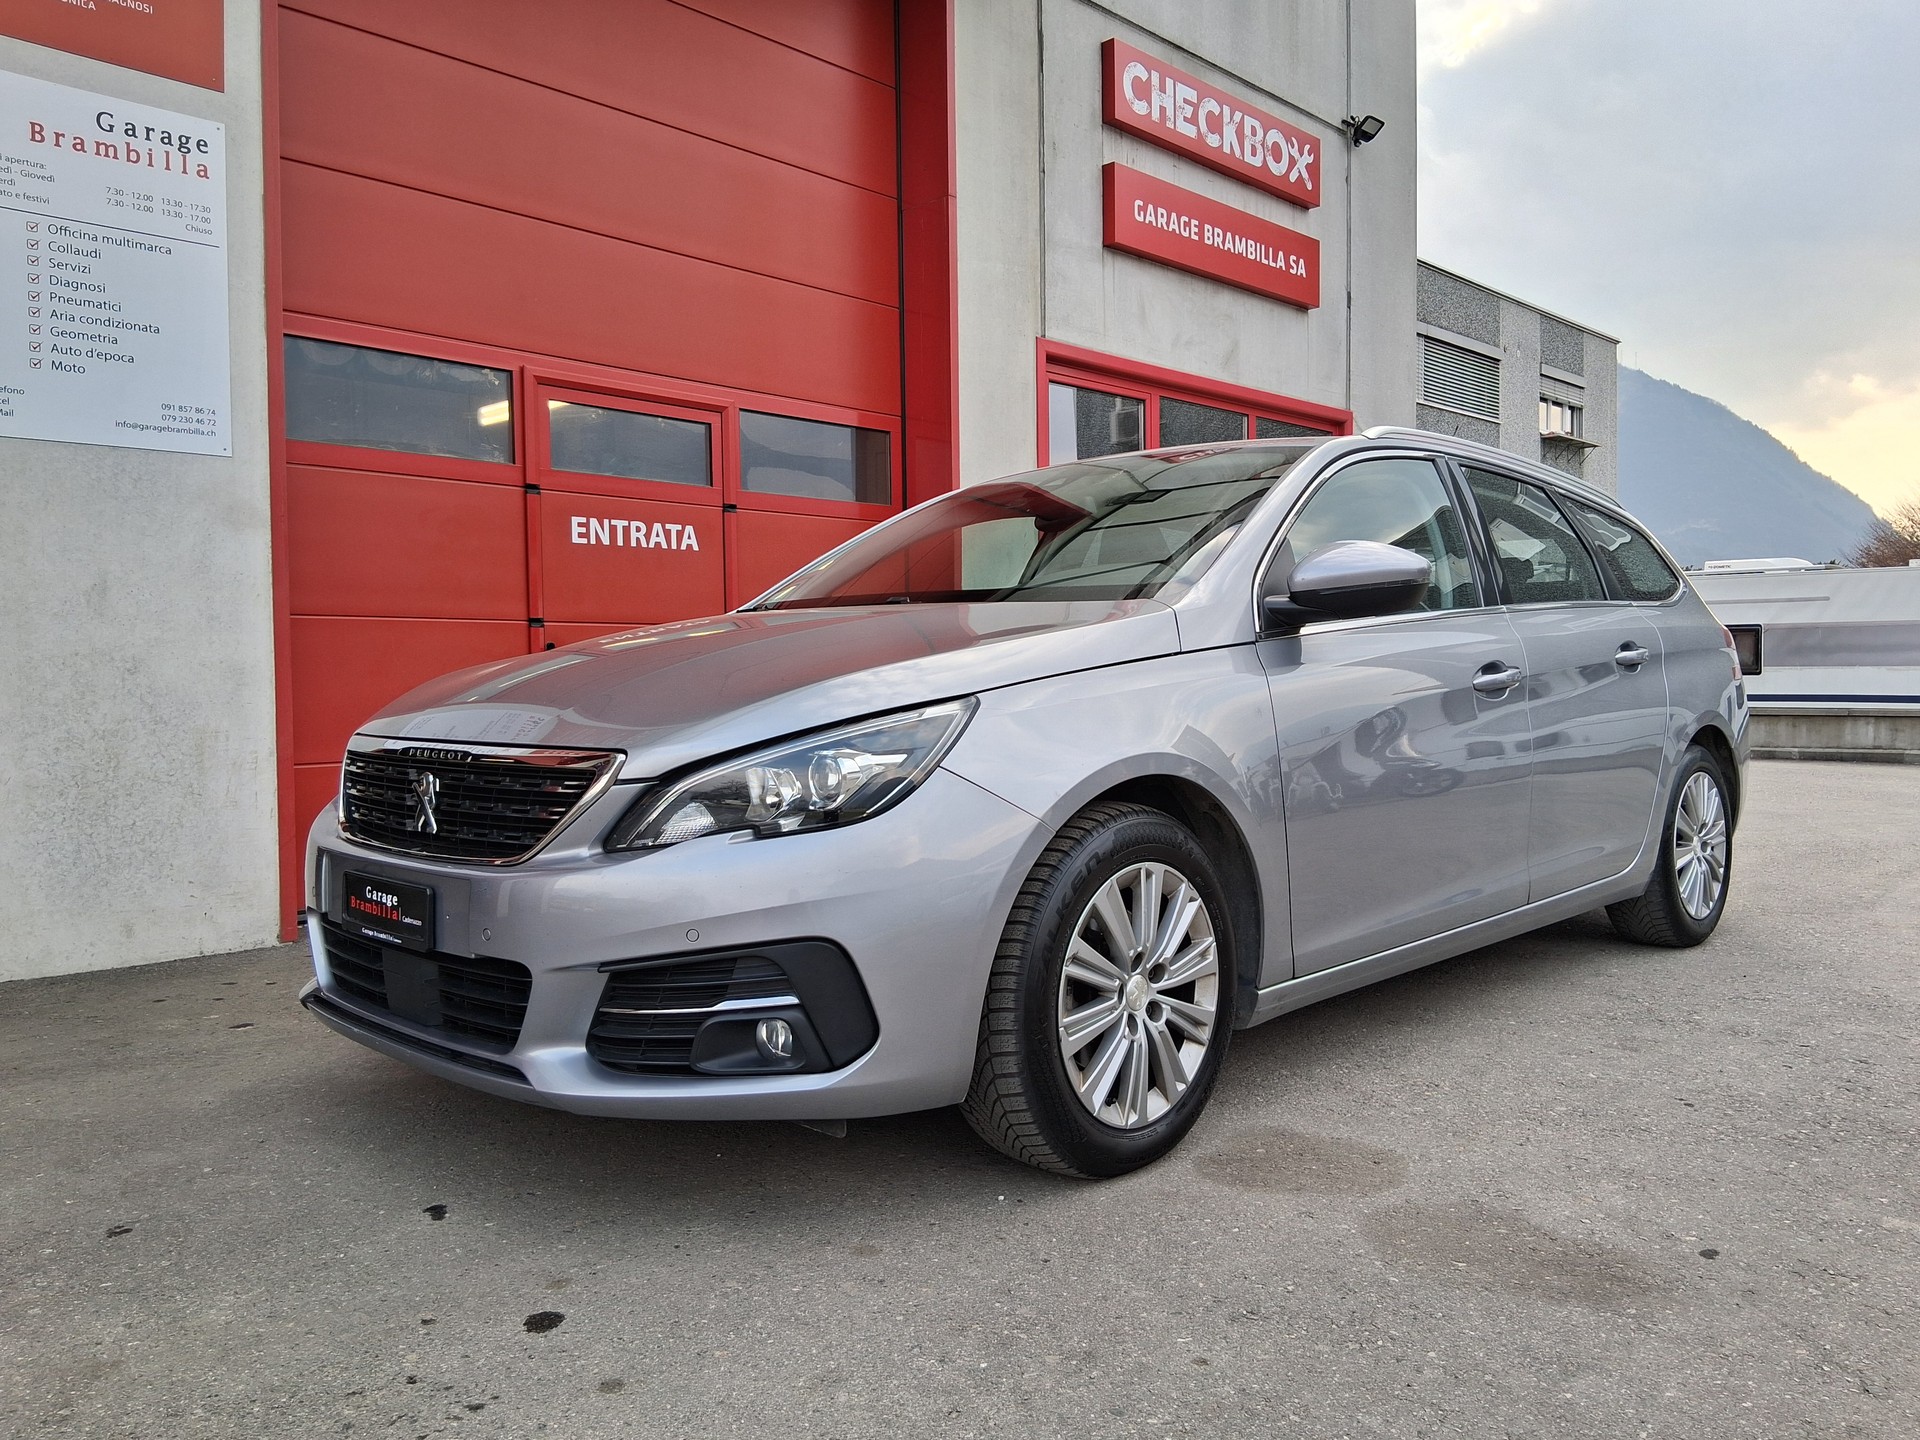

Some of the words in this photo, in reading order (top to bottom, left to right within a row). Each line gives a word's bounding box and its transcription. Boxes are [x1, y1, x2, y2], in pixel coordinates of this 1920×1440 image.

[95, 111, 209, 154] Garage
[1122, 61, 1314, 191] CHECKBOX
[28, 121, 210, 180] Brambilla
[4, 154, 47, 171] apertura:
[0, 177, 16, 187] erdì
[20, 168, 56, 184] Giovedì
[23, 192, 51, 205] festivi
[106, 186, 124, 197] 7.30
[131, 191, 154, 203] 12.00
[161, 197, 183, 208] 13.30
[190, 203, 211, 214] 17.30
[106, 198, 124, 208] 7.30
[132, 202, 154, 213] 12.00
[162, 208, 183, 219] 13.30
[191, 214, 212, 225] 17.00
[47, 222, 99, 243] Officina
[102, 235, 172, 256] multimarca
[185, 224, 213, 236] Chiuso
[1133, 199, 1199, 240] GARAGE
[1204, 223, 1286, 272] BRAMBILLA
[1289, 254, 1307, 278] SA
[48, 240, 102, 260] Collaudi
[48, 257, 91, 275] Servizi
[49, 274, 106, 294] Diagnosi
[49, 292, 122, 313] Pneumatici
[50, 309, 76, 323] Aria
[79, 313, 160, 335] condizionata
[50, 326, 118, 345] Geometria
[50, 343, 82, 357] Auto
[51, 360, 86, 375] Moto
[0, 385, 25, 395] efono
[161, 402, 176, 411] 091
[178, 404, 193, 413] 857
[195, 406, 205, 415] 86
[206, 407, 216, 416] 74
[115, 419, 217, 438] info@garagebrambilla.ch
[161, 413, 177, 422] 079
[178, 415, 194, 424] 230
[195, 417, 205, 425] 46
[207, 418, 217, 427] 72
[571, 516, 699, 551] ENTRATA
[408, 748, 464, 762] PEUGEOT
[365, 885, 398, 907] Garage
[350, 895, 399, 921] Brambilla
